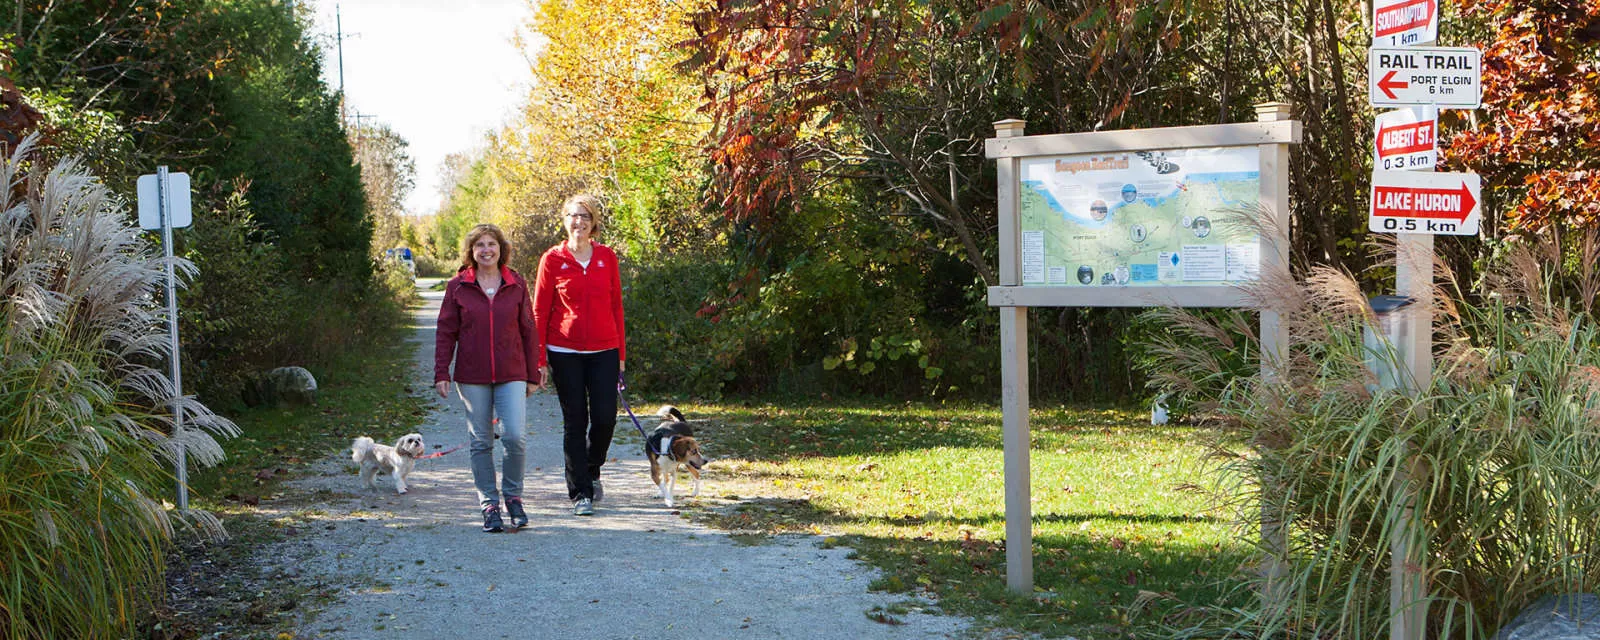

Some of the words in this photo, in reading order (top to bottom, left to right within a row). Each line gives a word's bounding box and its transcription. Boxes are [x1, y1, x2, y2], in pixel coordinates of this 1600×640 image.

[1377, 1, 1428, 32] SOUTHAMPTON
[1391, 36, 1396, 46] 1
[1401, 33, 1418, 45] km
[1380, 54, 1419, 69] RAIL
[1424, 55, 1473, 70] TRAIL
[1411, 75, 1438, 85] PORT
[1442, 76, 1472, 85] ELGIN
[1429, 85, 1436, 95] 6
[1439, 86, 1454, 95] km
[1382, 127, 1416, 151] ALBERT
[1417, 125, 1433, 145] ST.
[1384, 156, 1405, 170] 0.3
[1410, 155, 1428, 167] km
[1376, 191, 1412, 210] LAKE
[1414, 193, 1461, 212] HURON
[1383, 218, 1417, 231] 0.5
[1427, 220, 1456, 232] km
